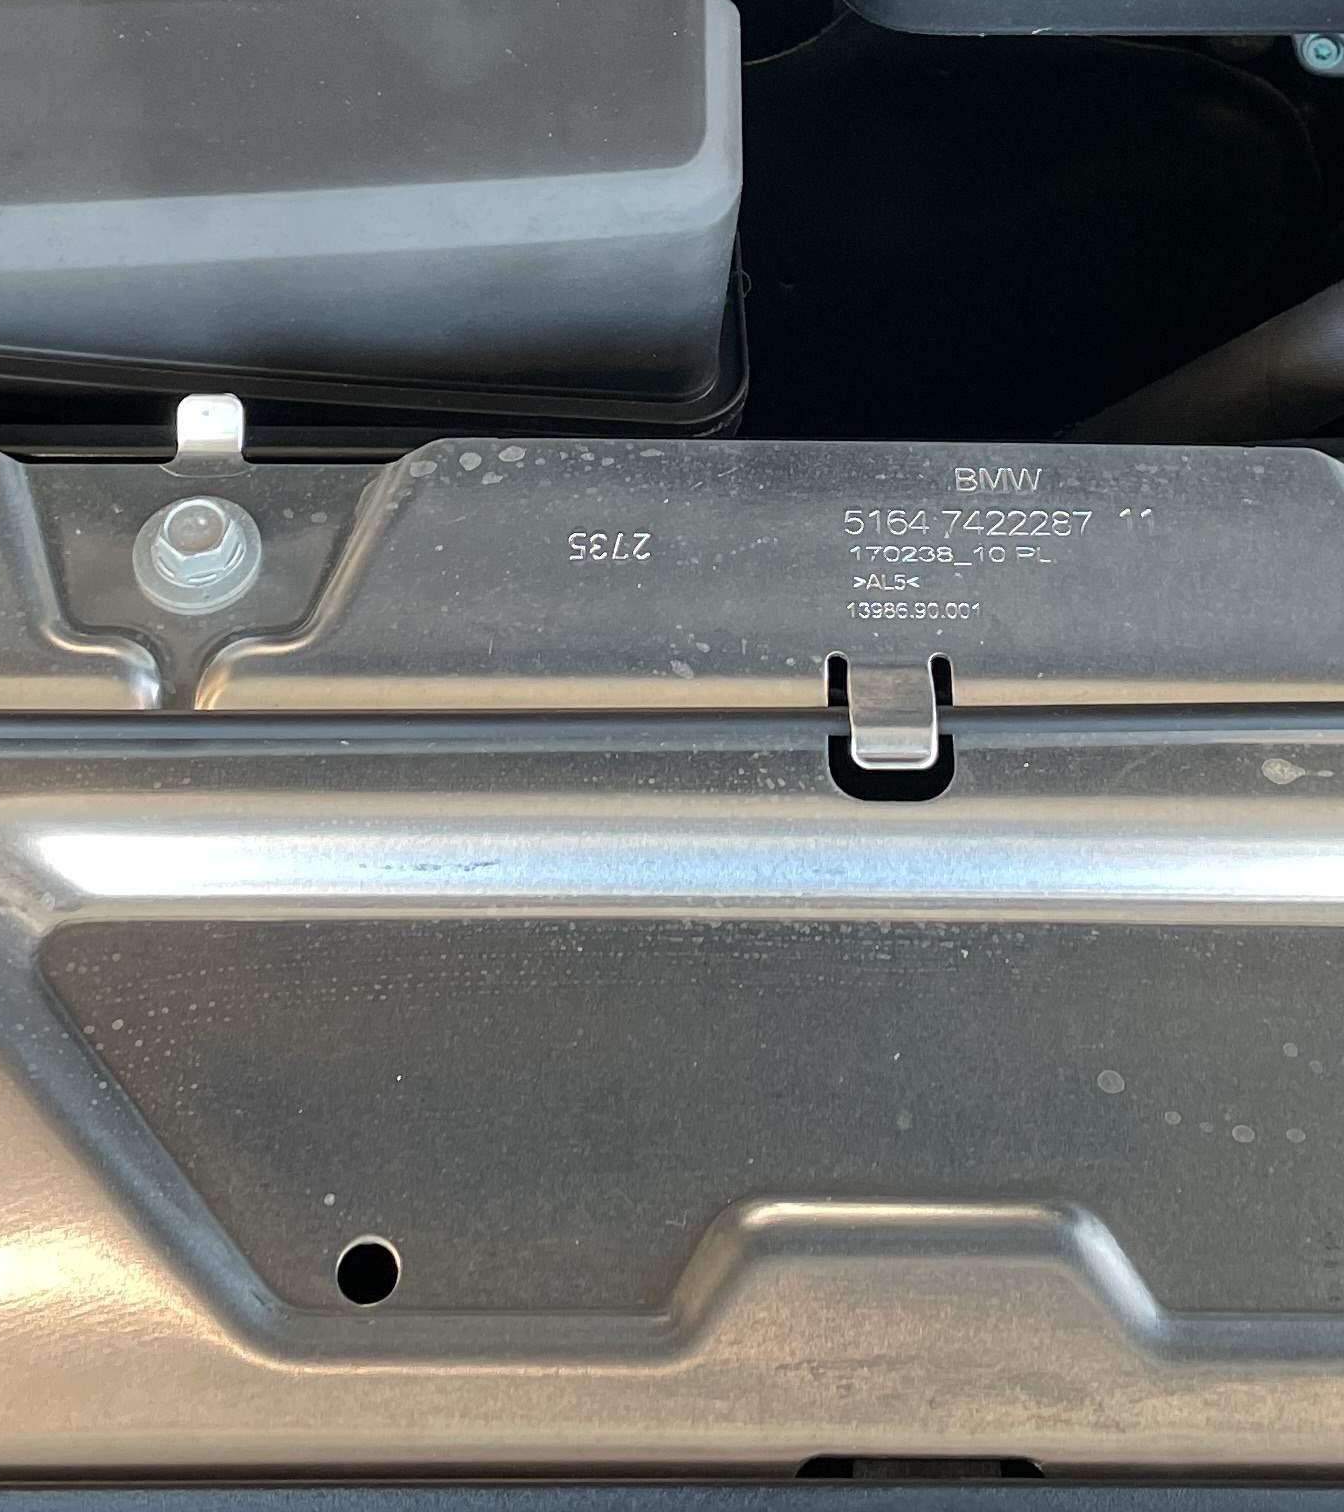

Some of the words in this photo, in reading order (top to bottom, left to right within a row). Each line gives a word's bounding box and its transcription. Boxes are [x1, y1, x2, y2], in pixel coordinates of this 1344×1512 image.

[954, 467, 1043, 492] BMW
[844, 509, 930, 536] 5164
[941, 510, 1093, 536] 7422287
[568, 532, 652, 560] 2735
[850, 546, 1005, 566] 170238_10
